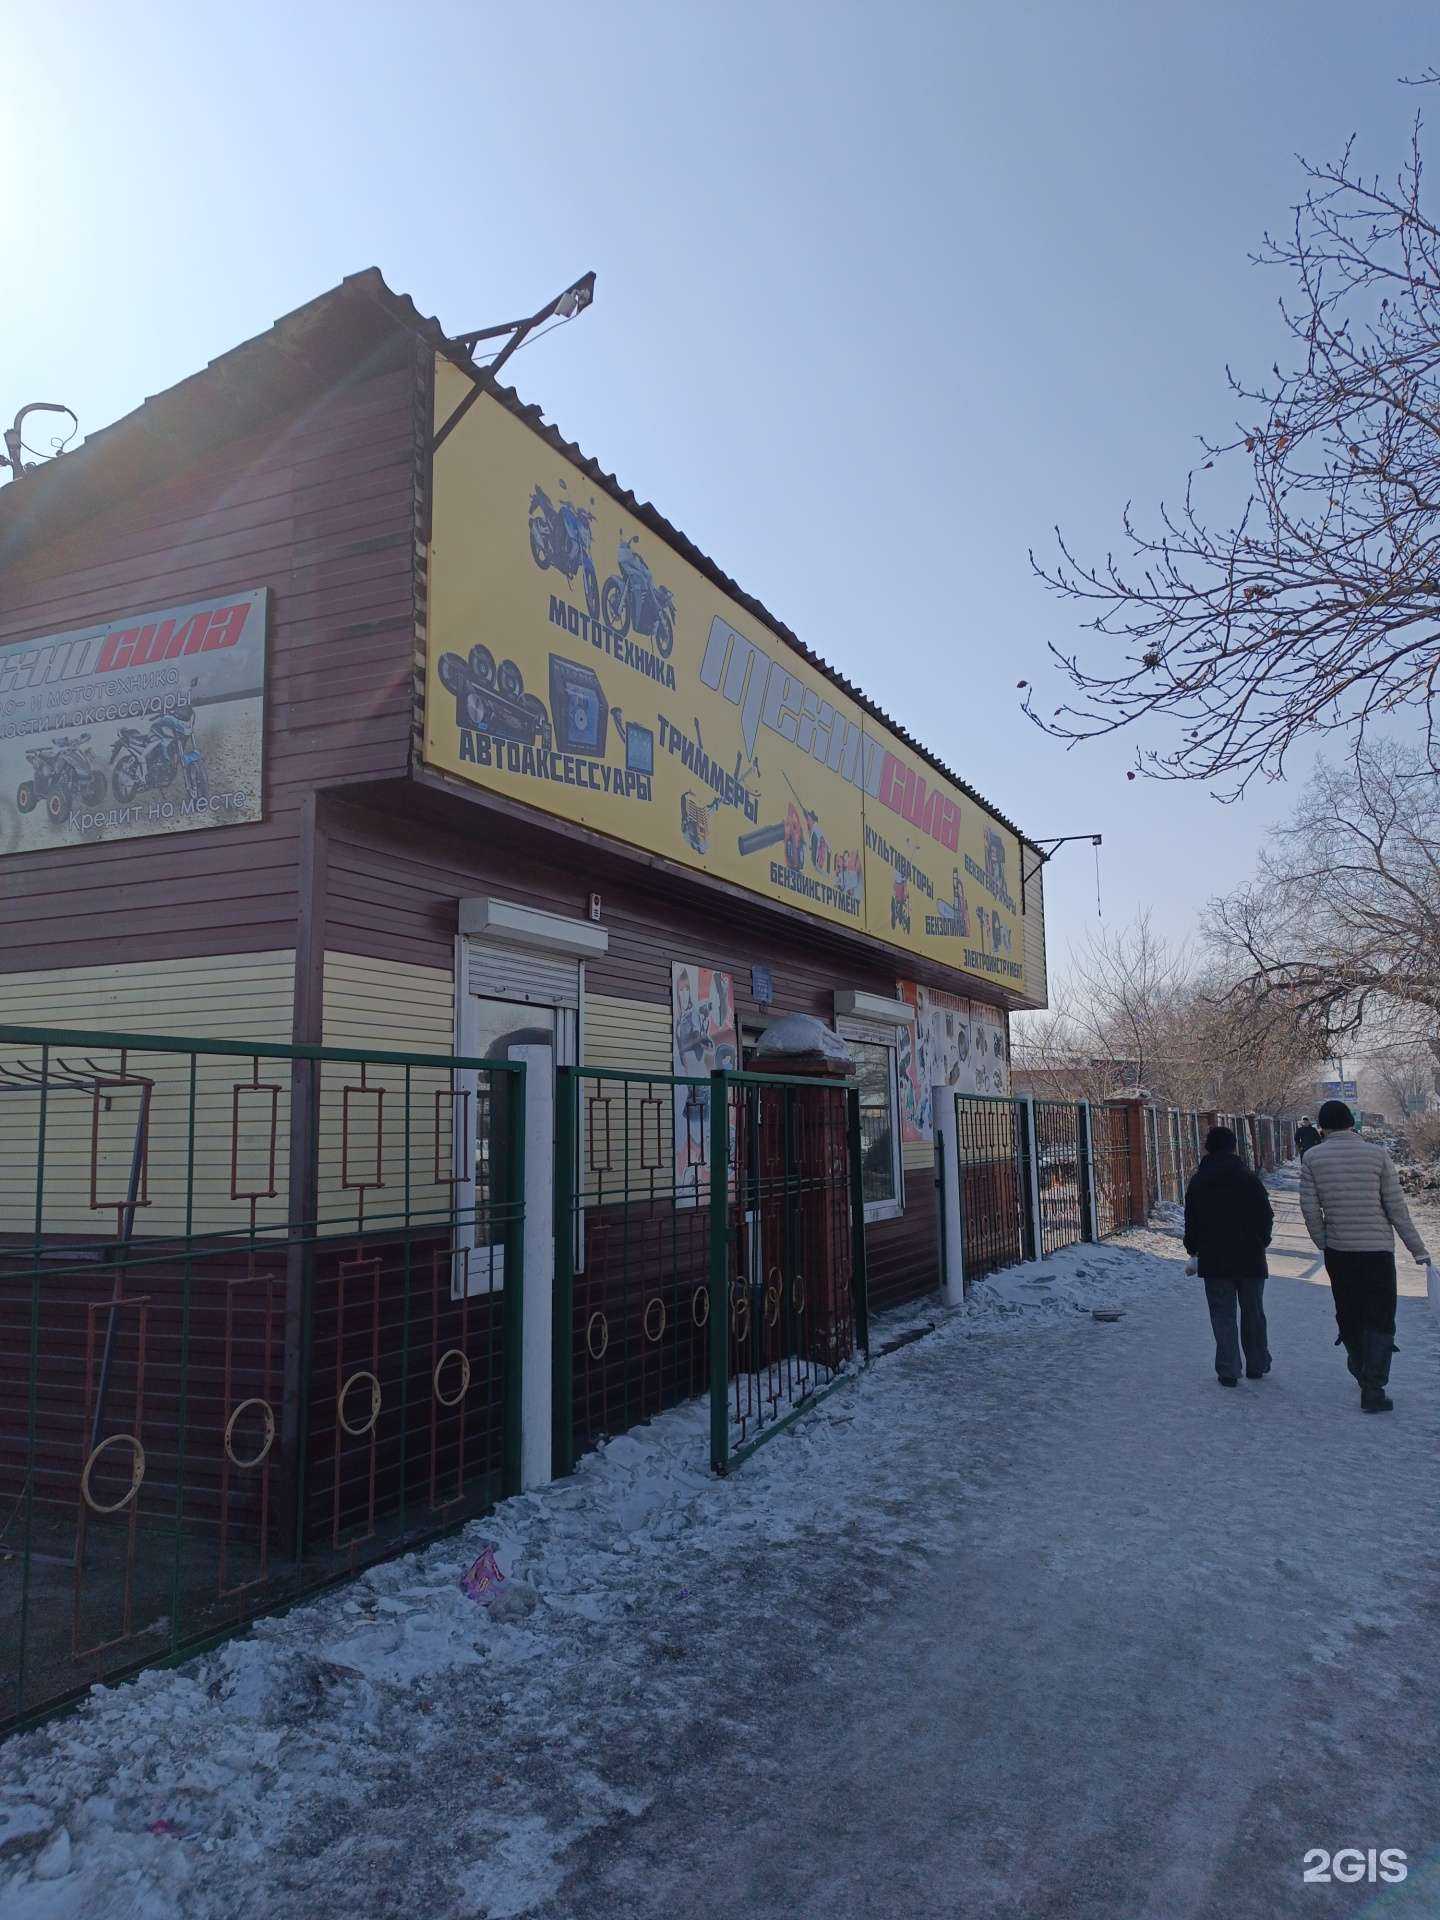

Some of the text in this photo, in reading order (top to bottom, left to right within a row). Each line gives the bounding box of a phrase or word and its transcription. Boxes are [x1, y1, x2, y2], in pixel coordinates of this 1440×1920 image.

[549, 594, 676, 691] МОТОТЕХНИКА
[72, 687, 191, 727] аксессуары
[459, 729, 652, 801] АВТОАКСЕССУАРЫ
[658, 711, 758, 825] ТРИММЕРЫ
[68, 790, 247, 833] Кредит на месте
[769, 861, 860, 917] БЕНЗОИНСТРУМЕНТ
[865, 822, 934, 900] КУЛЬТИВАТОРЫ
